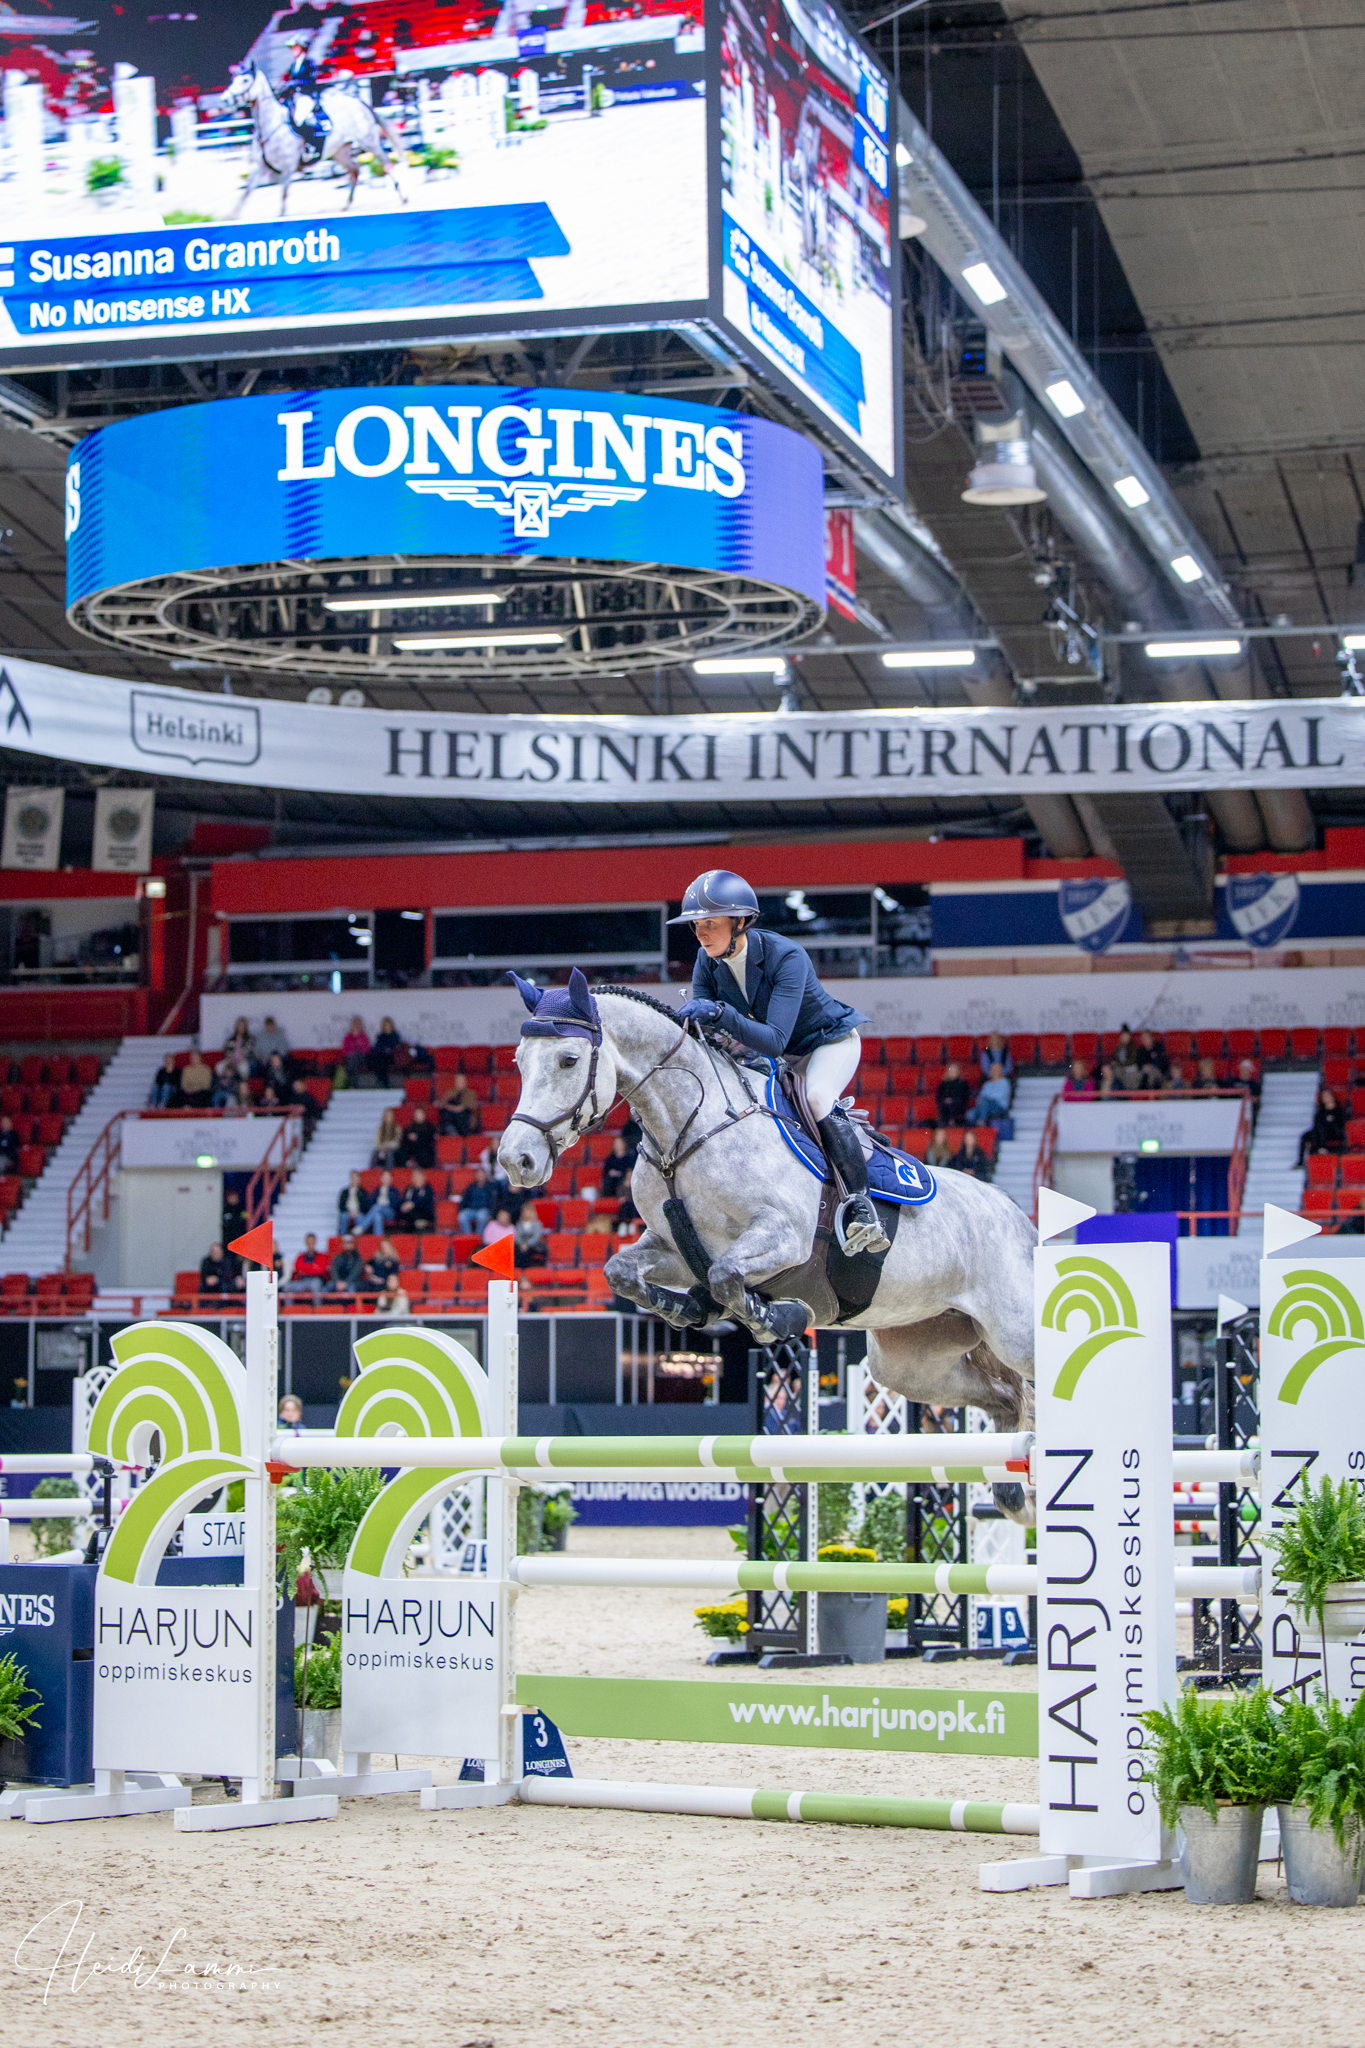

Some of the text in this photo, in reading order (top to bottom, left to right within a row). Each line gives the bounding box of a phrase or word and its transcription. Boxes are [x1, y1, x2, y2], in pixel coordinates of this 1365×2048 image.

[29, 228, 340, 283] Susanna Granroth
[29, 287, 251, 328] No Nonsense HX
[277, 405, 746, 498] LONGINES
[147, 714, 243, 746] Helsinki
[384, 716, 1344, 784] HELSINKI INTERNATIONAL
[572, 1483, 665, 1501] JUMPING
[665, 1483, 742, 1501] WORLD
[99, 1607, 252, 1657] HARJUN
[347, 1598, 494, 1646] HARJUN
[1005, 1611, 1016, 1632] 9
[1045, 1449, 1111, 1813] HARJUN
[1118, 1448, 1149, 1815] oppimiskeskus
[99, 1663, 252, 1683] oppimiskeskus
[347, 1650, 494, 1671] oppimiskeskus
[533, 1717, 548, 1747] 3
[728, 1694, 1005, 1741] www.harjunopk.fi
[525, 1758, 566, 1771] LONGINES
